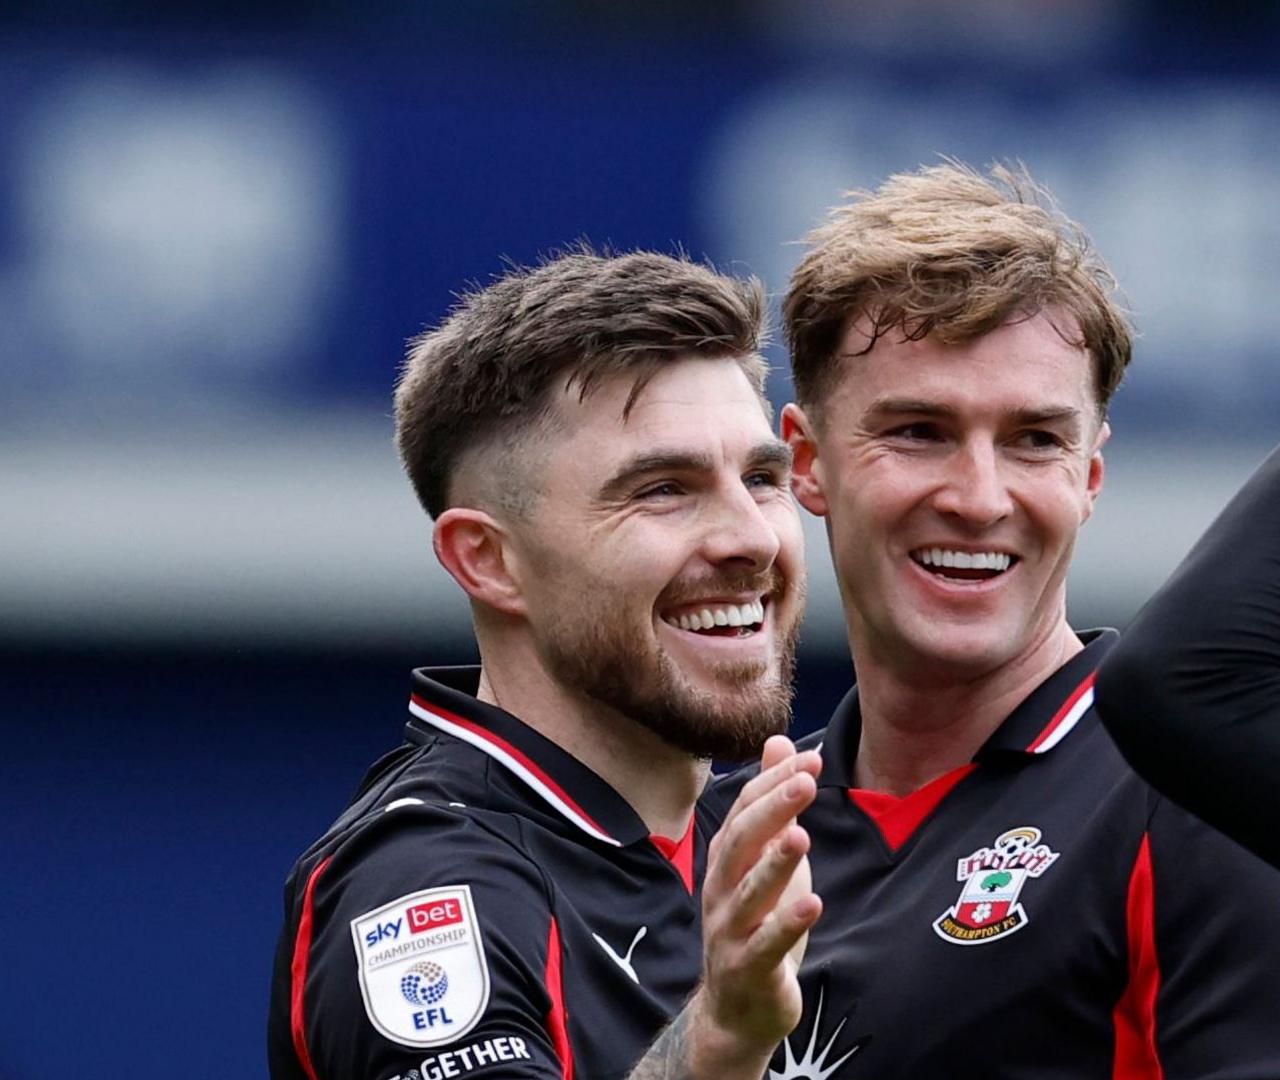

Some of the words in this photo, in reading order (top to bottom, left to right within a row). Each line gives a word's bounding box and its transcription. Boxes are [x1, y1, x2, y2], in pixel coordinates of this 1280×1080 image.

[365, 917, 403, 948] sky
[411, 901, 459, 928] bet
[369, 928, 467, 966] CHAMPIONSHIP
[412, 1008, 453, 1030] EFL
